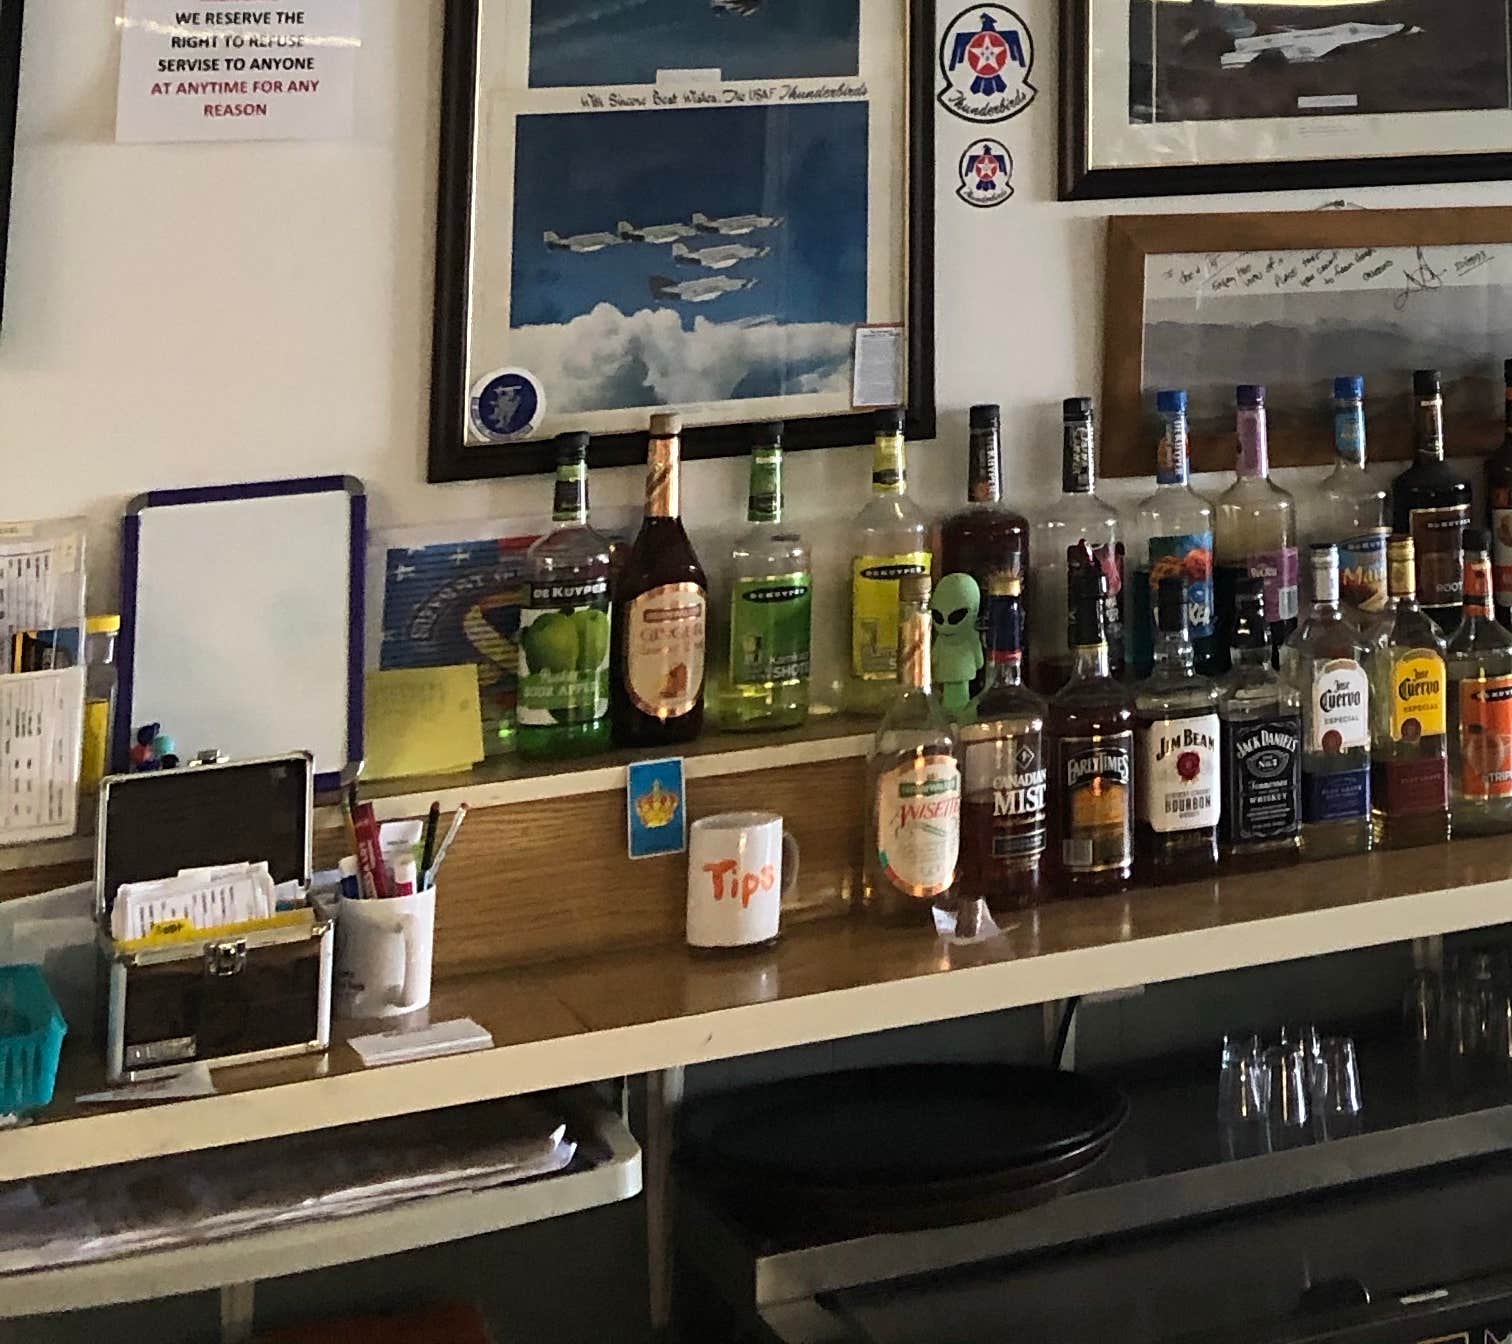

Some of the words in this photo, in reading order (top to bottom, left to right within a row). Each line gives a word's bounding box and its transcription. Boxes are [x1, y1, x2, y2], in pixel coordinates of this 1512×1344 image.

[175, 12, 200, 25] WE
[205, 12, 271, 24] RESERVE
[276, 12, 304, 24] THE
[171, 36, 217, 48] RIGHT
[224, 36, 244, 48] TO
[158, 59, 219, 72] SERVISE
[225, 59, 245, 71] TO
[250, 57, 314, 70] ANYONE
[151, 82, 170, 95] AT
[176, 81, 248, 94] ANYTIME
[253, 81, 282, 93] FOR
[287, 80, 320, 92] ANY
[779, 82, 868, 100] Thunderbirds
[204, 104, 267, 116] REASON
[948, 88, 1028, 117] Thunderbirds
[552, 582, 608, 599] KUYPER
[1398, 679, 1440, 702] Cuervo
[1320, 689, 1362, 713] Cuervo
[1156, 734, 1181, 762] JIM
[1182, 729, 1215, 752] BEAM
[1236, 735, 1261, 760] JACK
[993, 787, 1047, 816] MIST
[1164, 797, 1211, 814] BOURBON
[704, 858, 775, 908] Tips
